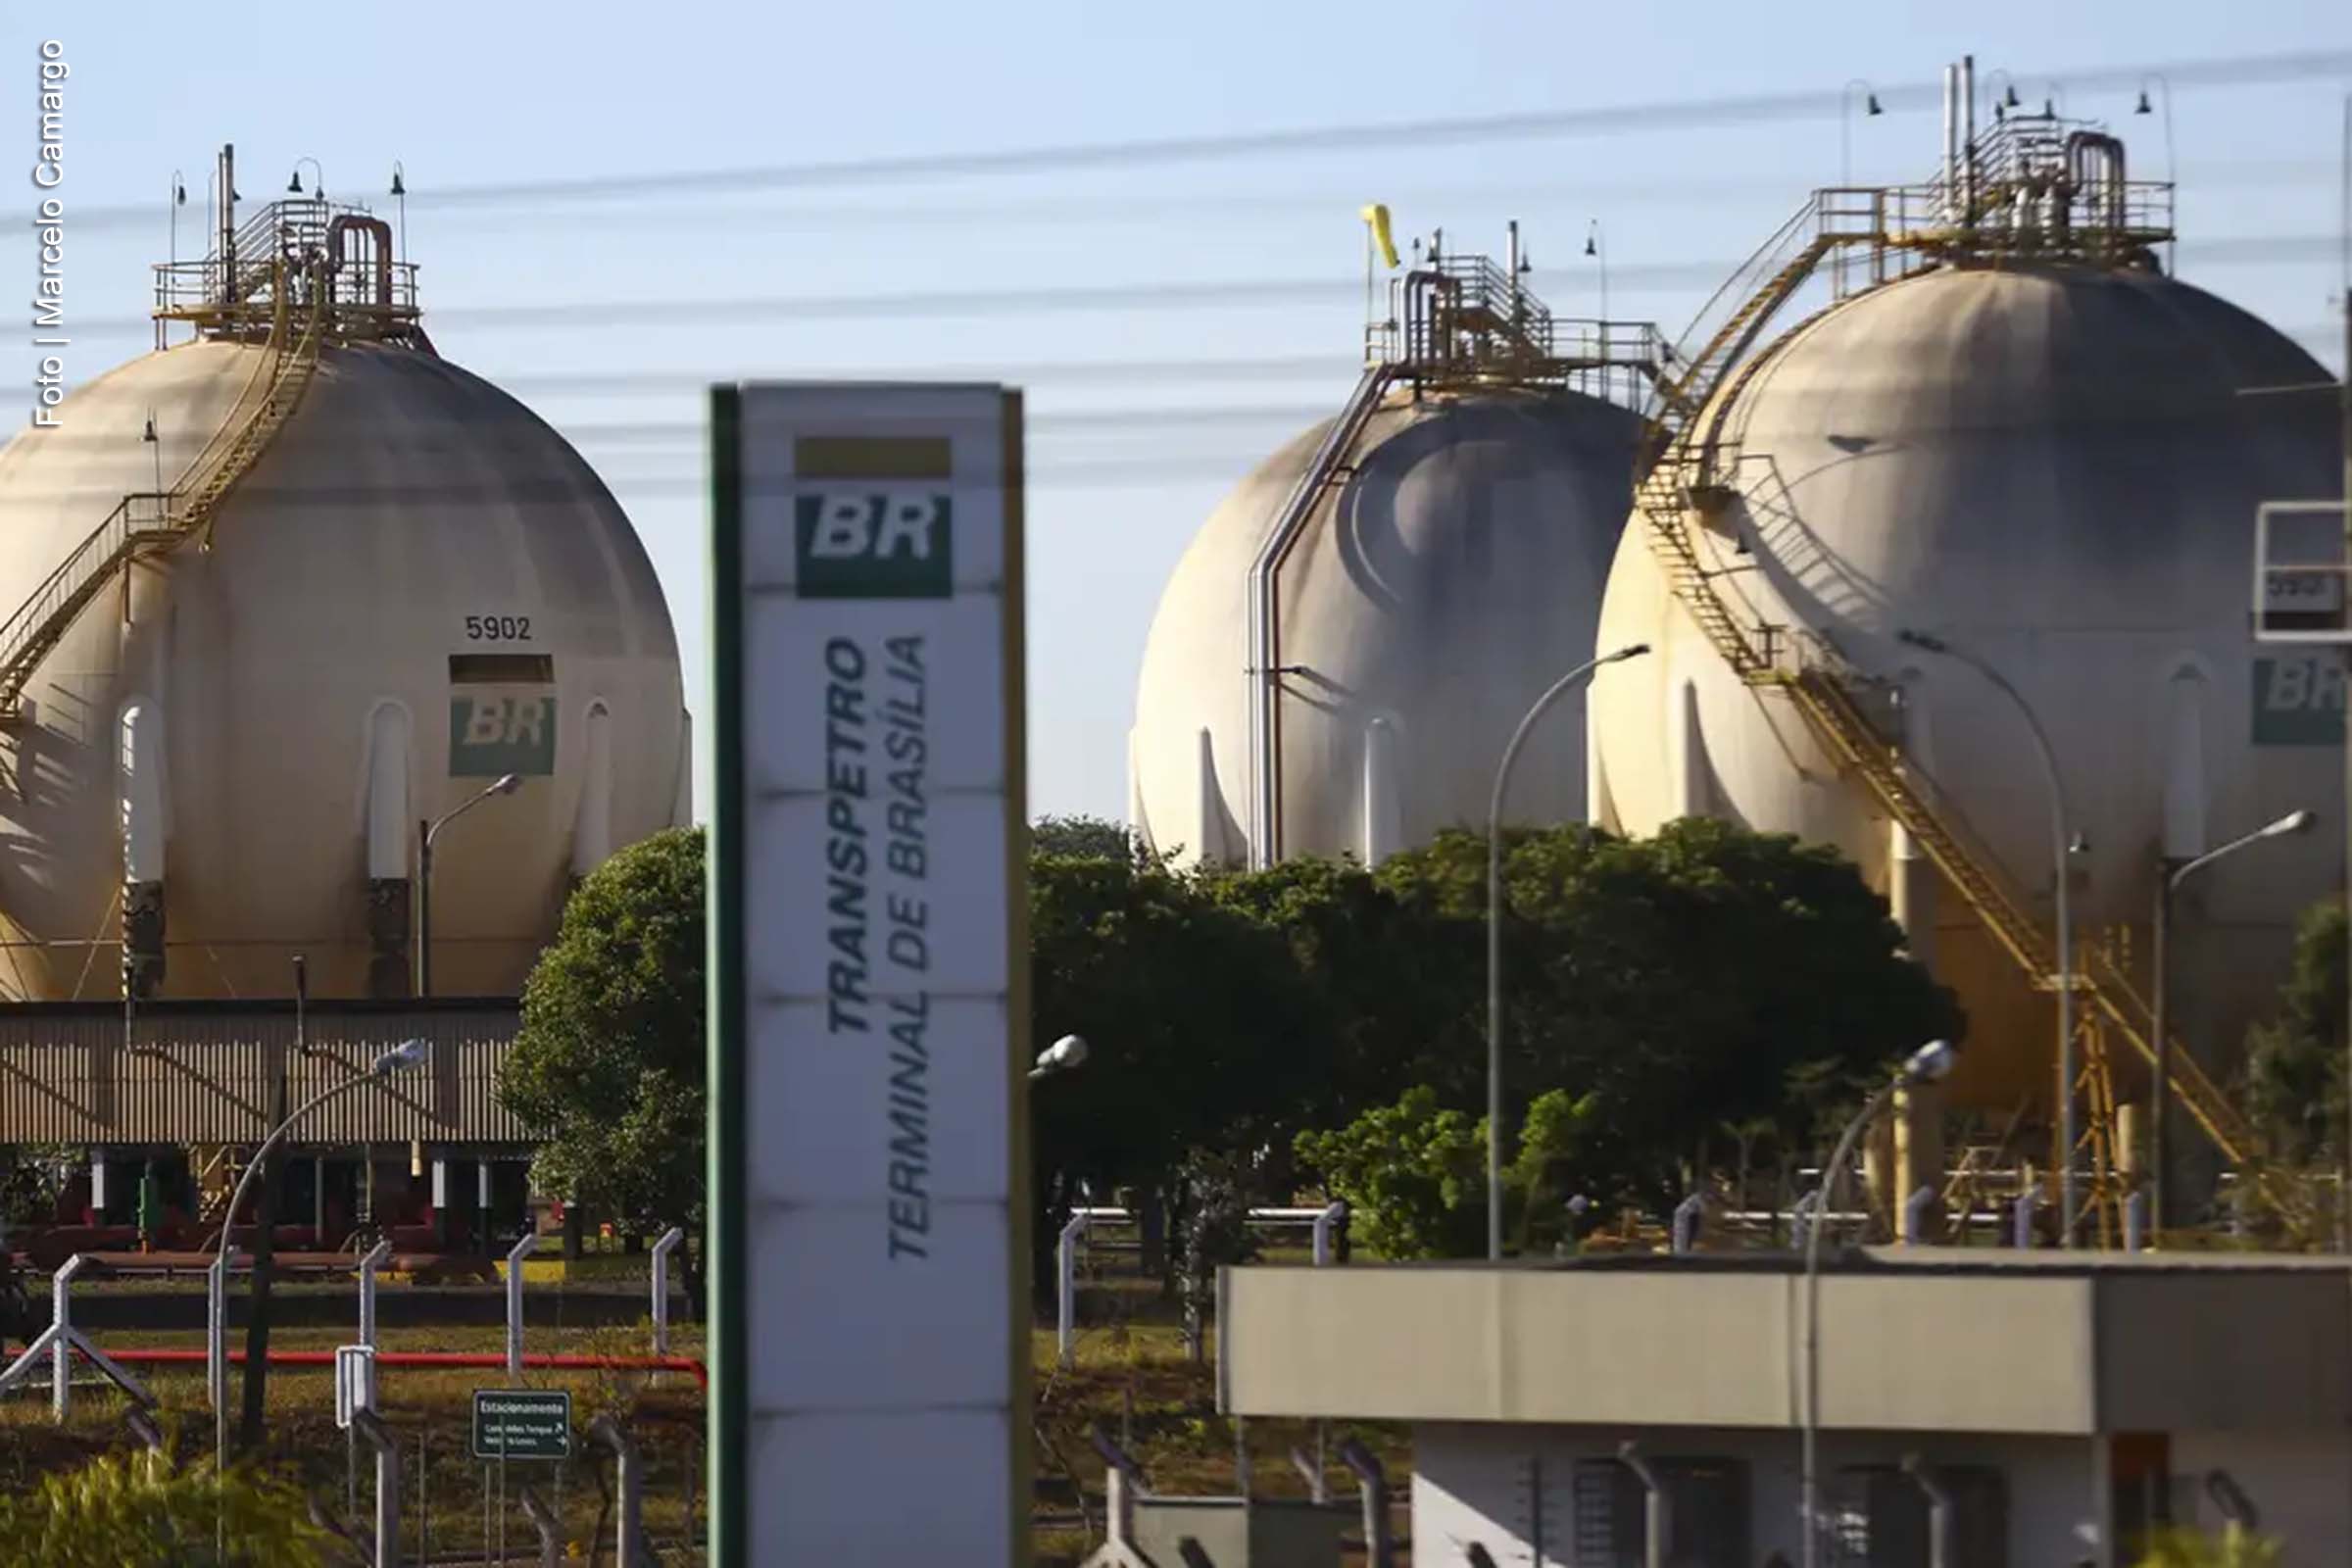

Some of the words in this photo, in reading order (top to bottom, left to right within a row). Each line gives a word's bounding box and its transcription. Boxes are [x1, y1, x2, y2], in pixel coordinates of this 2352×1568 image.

[810, 493, 938, 559] BR
[466, 615, 532, 640] 5902
[463, 698, 545, 747] BR
[876, 634, 928, 879] BRASÍLIA
[825, 635, 868, 1035] TRANSPETRO
[887, 893, 928, 973] DE
[887, 992, 929, 1261] TERMINAL
[480, 1400, 564, 1414] Estacionamento
